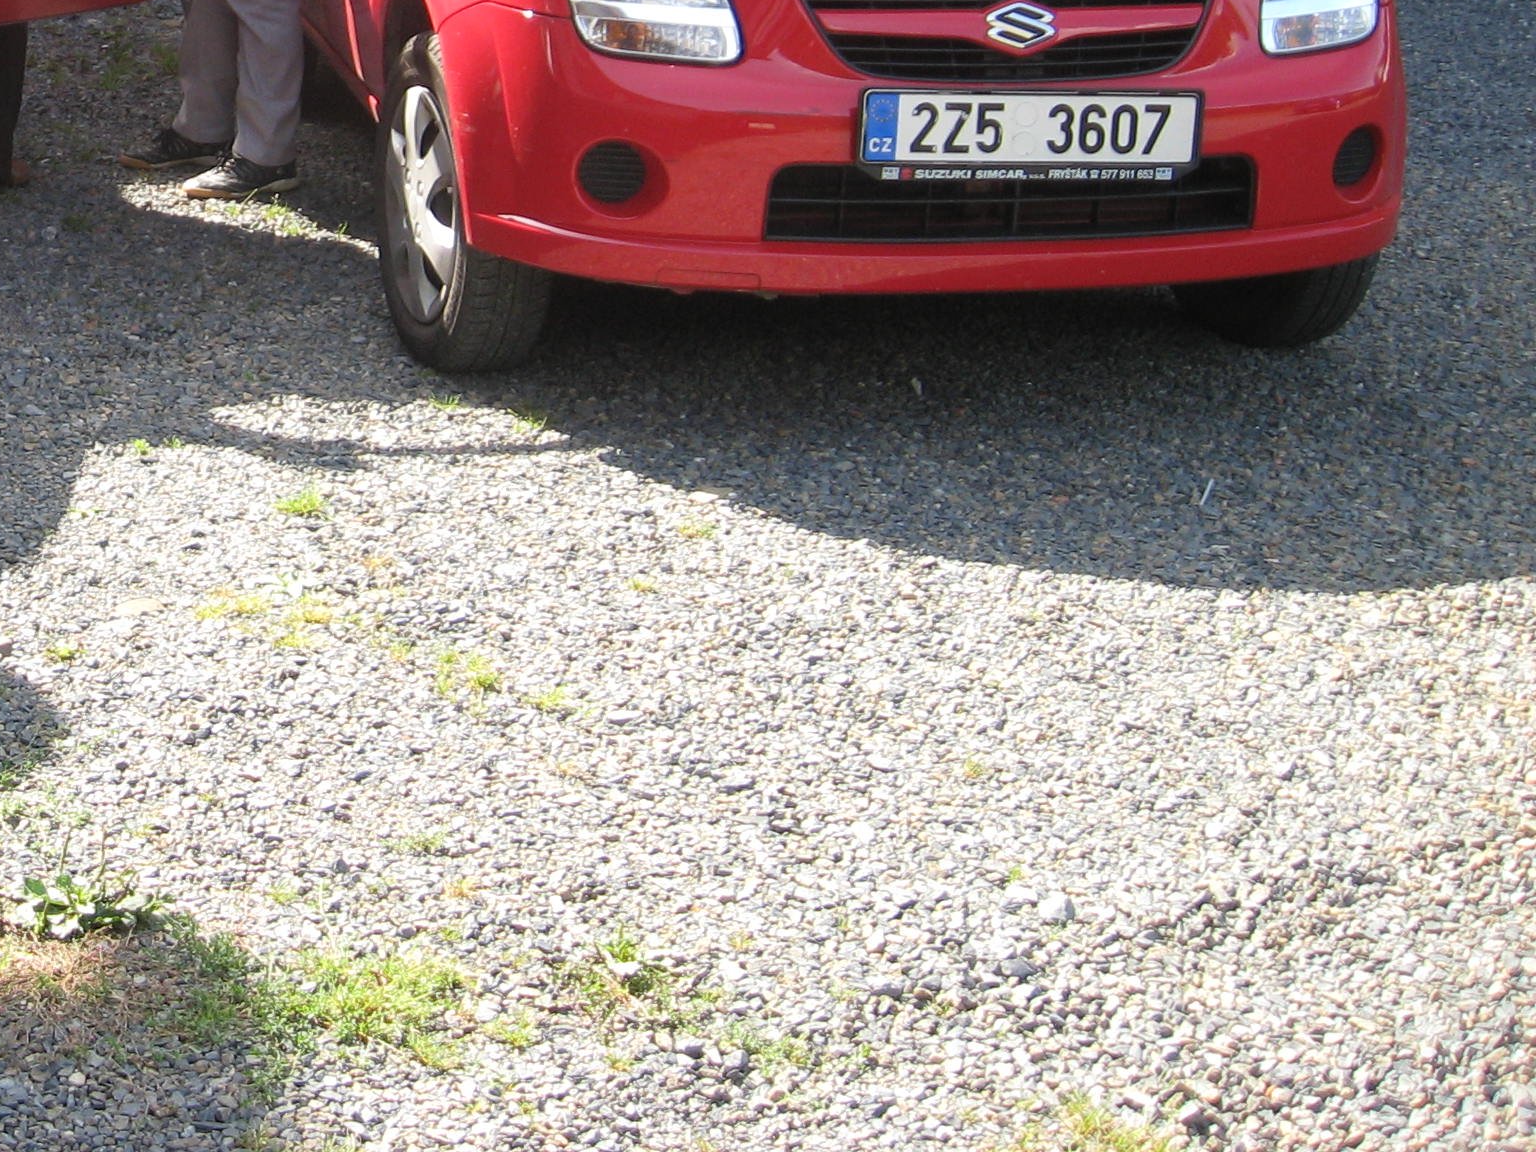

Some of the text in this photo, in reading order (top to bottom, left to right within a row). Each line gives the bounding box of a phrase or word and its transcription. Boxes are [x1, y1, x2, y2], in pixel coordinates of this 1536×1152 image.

[909, 102, 1172, 155] 2Z5 3607
[869, 137, 893, 152] CZ
[914, 168, 972, 179] SUZUKI
[1119, 168, 1135, 179] 911
